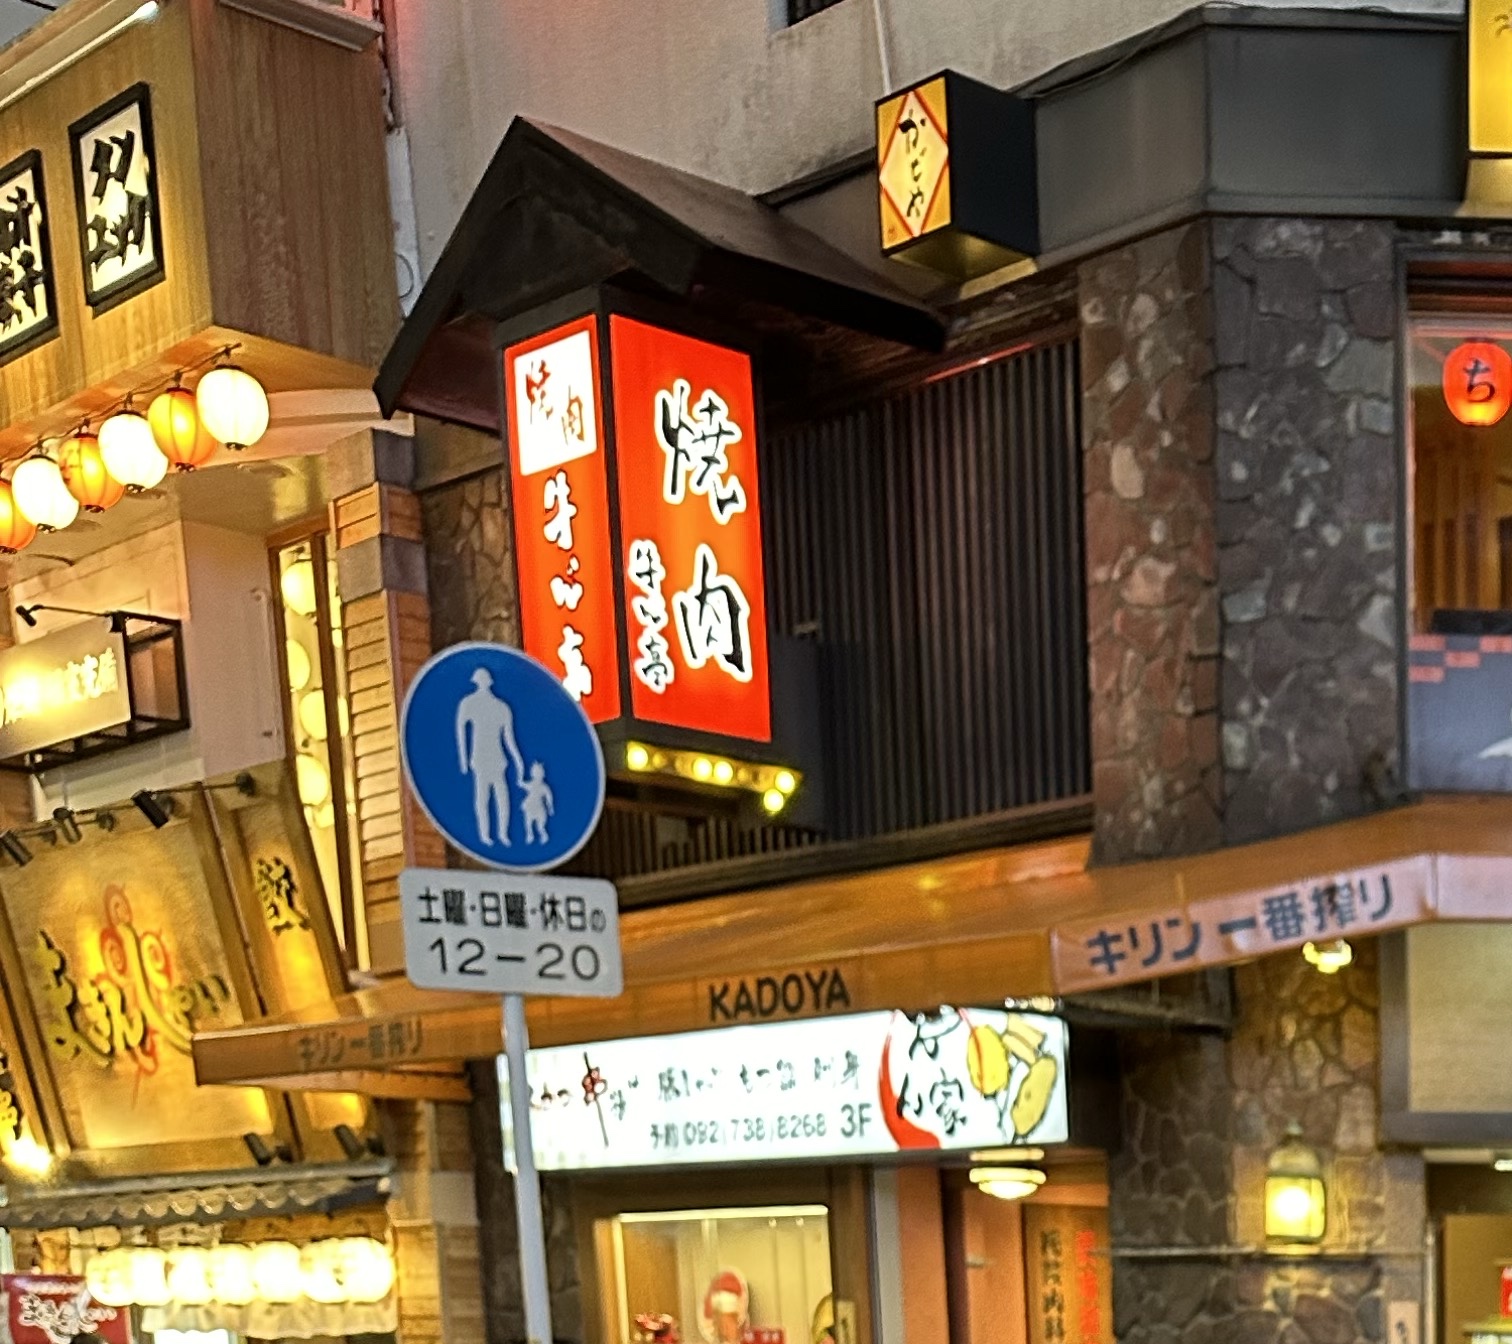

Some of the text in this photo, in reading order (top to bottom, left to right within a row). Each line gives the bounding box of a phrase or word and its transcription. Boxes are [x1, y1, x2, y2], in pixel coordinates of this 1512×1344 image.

[657, 381, 751, 679] 焼肉
[707, 968, 851, 1022] KADOYA
[840, 1102, 873, 1139] 3F
